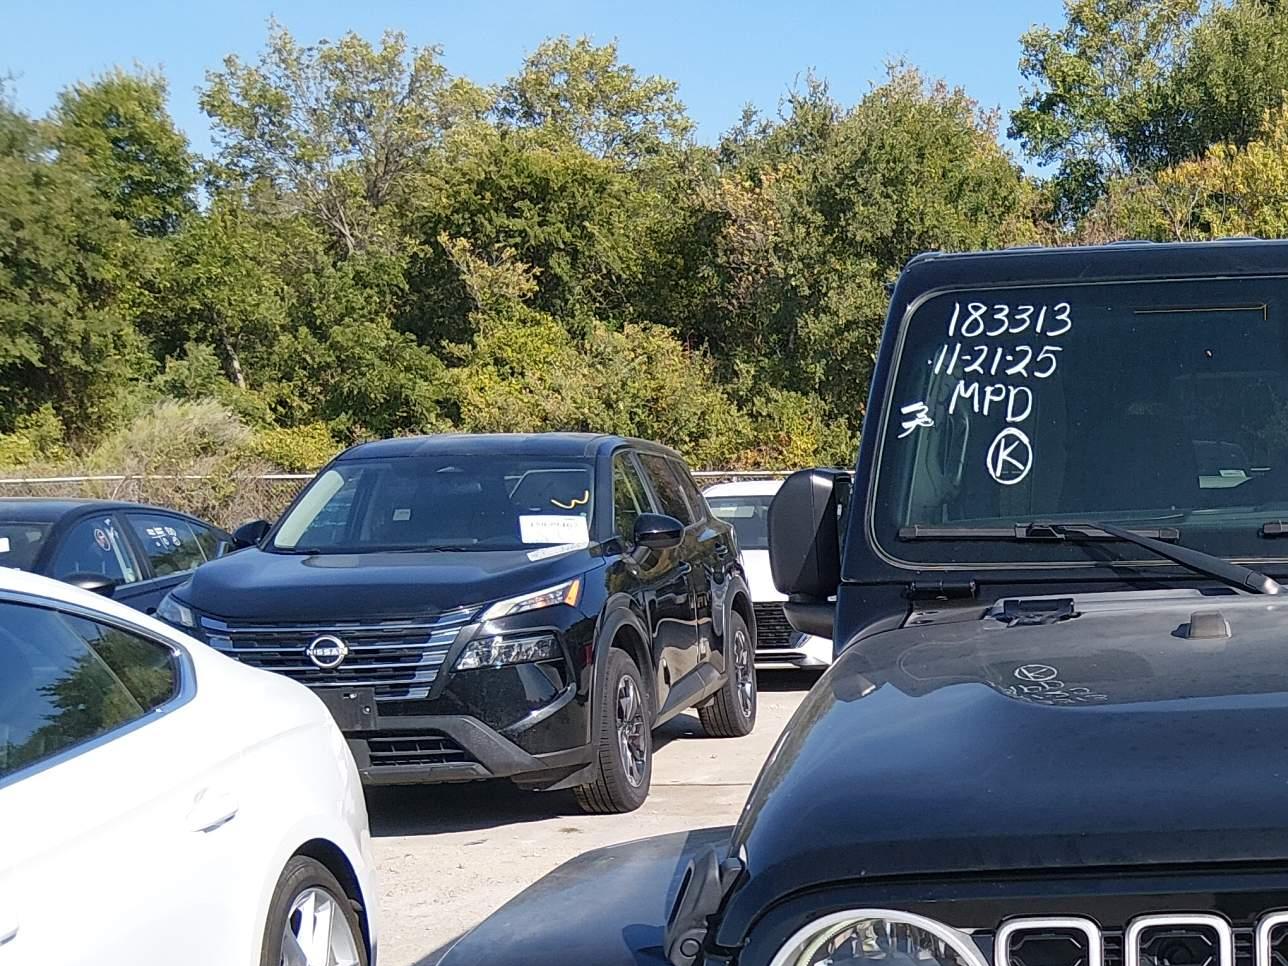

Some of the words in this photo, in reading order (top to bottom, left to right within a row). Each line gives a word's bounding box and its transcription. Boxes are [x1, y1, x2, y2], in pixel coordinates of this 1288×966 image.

[949, 302, 1073, 337] 183313
[949, 379, 1033, 423] MPD
[993, 434, 1027, 478] K
[306, 647, 348, 656] NISSAN
